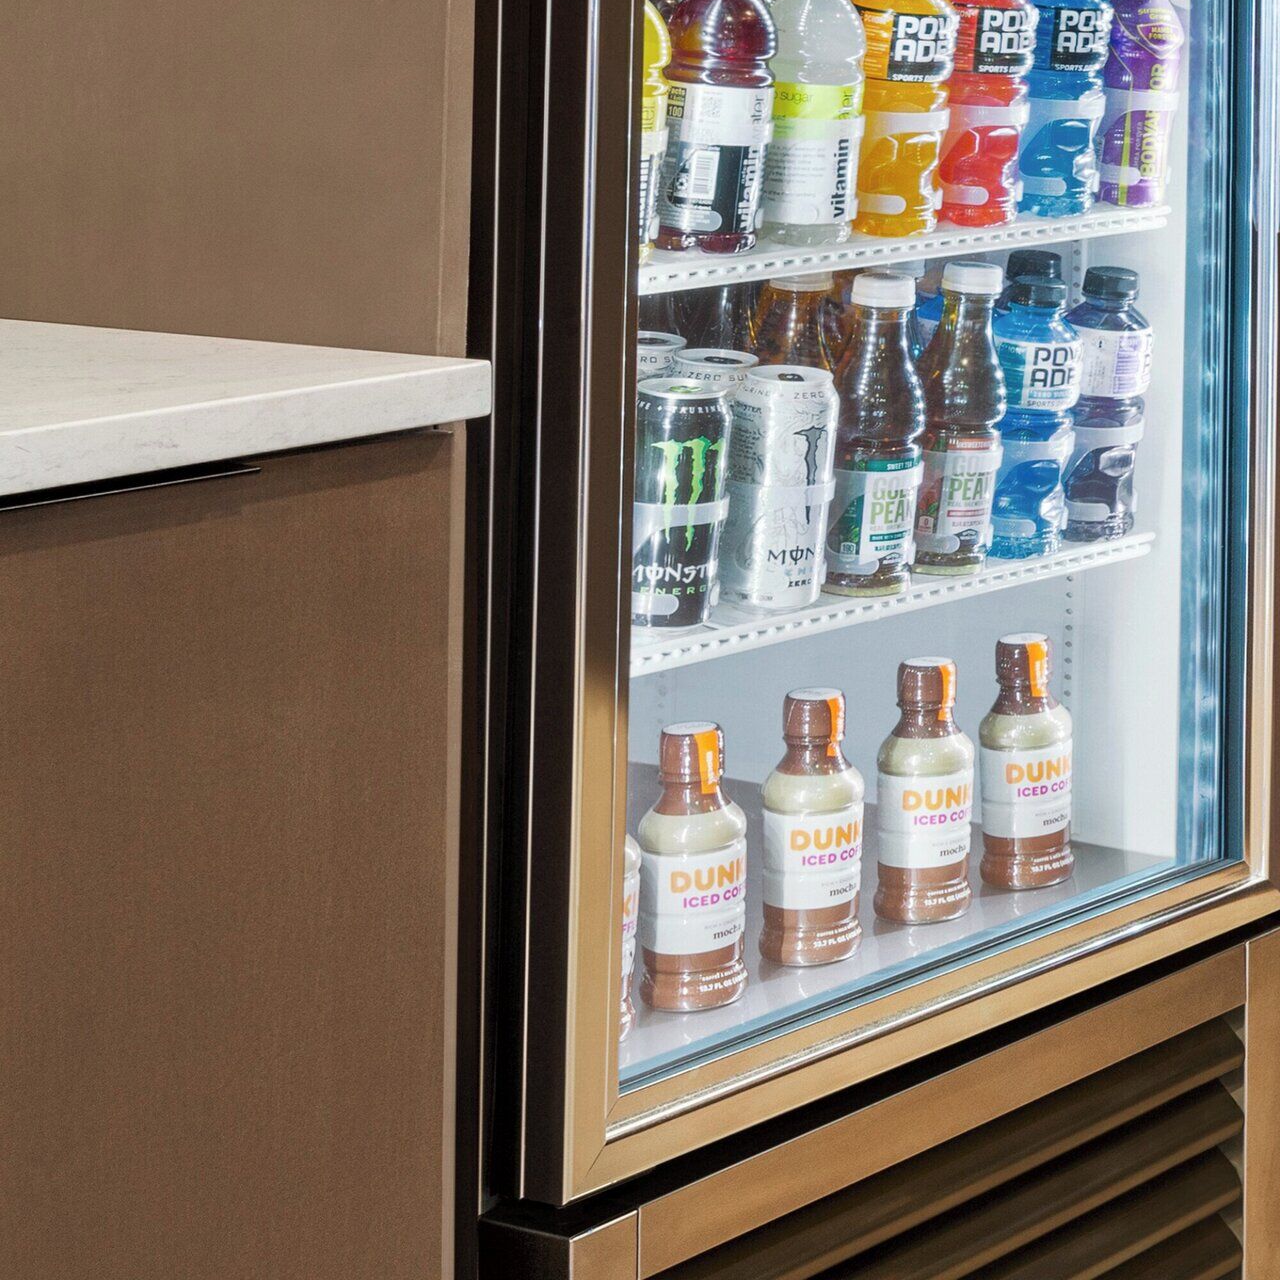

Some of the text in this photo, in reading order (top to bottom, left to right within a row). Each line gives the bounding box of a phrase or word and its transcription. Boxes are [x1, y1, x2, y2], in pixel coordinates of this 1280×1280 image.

[978, 64, 1008, 73] SPORTS
[780, 91, 814, 106] sugar
[668, 104, 683, 118] 100
[1139, 63, 1169, 178] BODYAOR
[687, 369, 722, 383] ZERO
[793, 390, 826, 401] ZERO
[640, 586, 708, 597] ENERG
[1017, 785, 1048, 798] ICED
[914, 814, 948, 826] ICED
[801, 850, 837, 866] ICED
[682, 892, 720, 909] ICED
